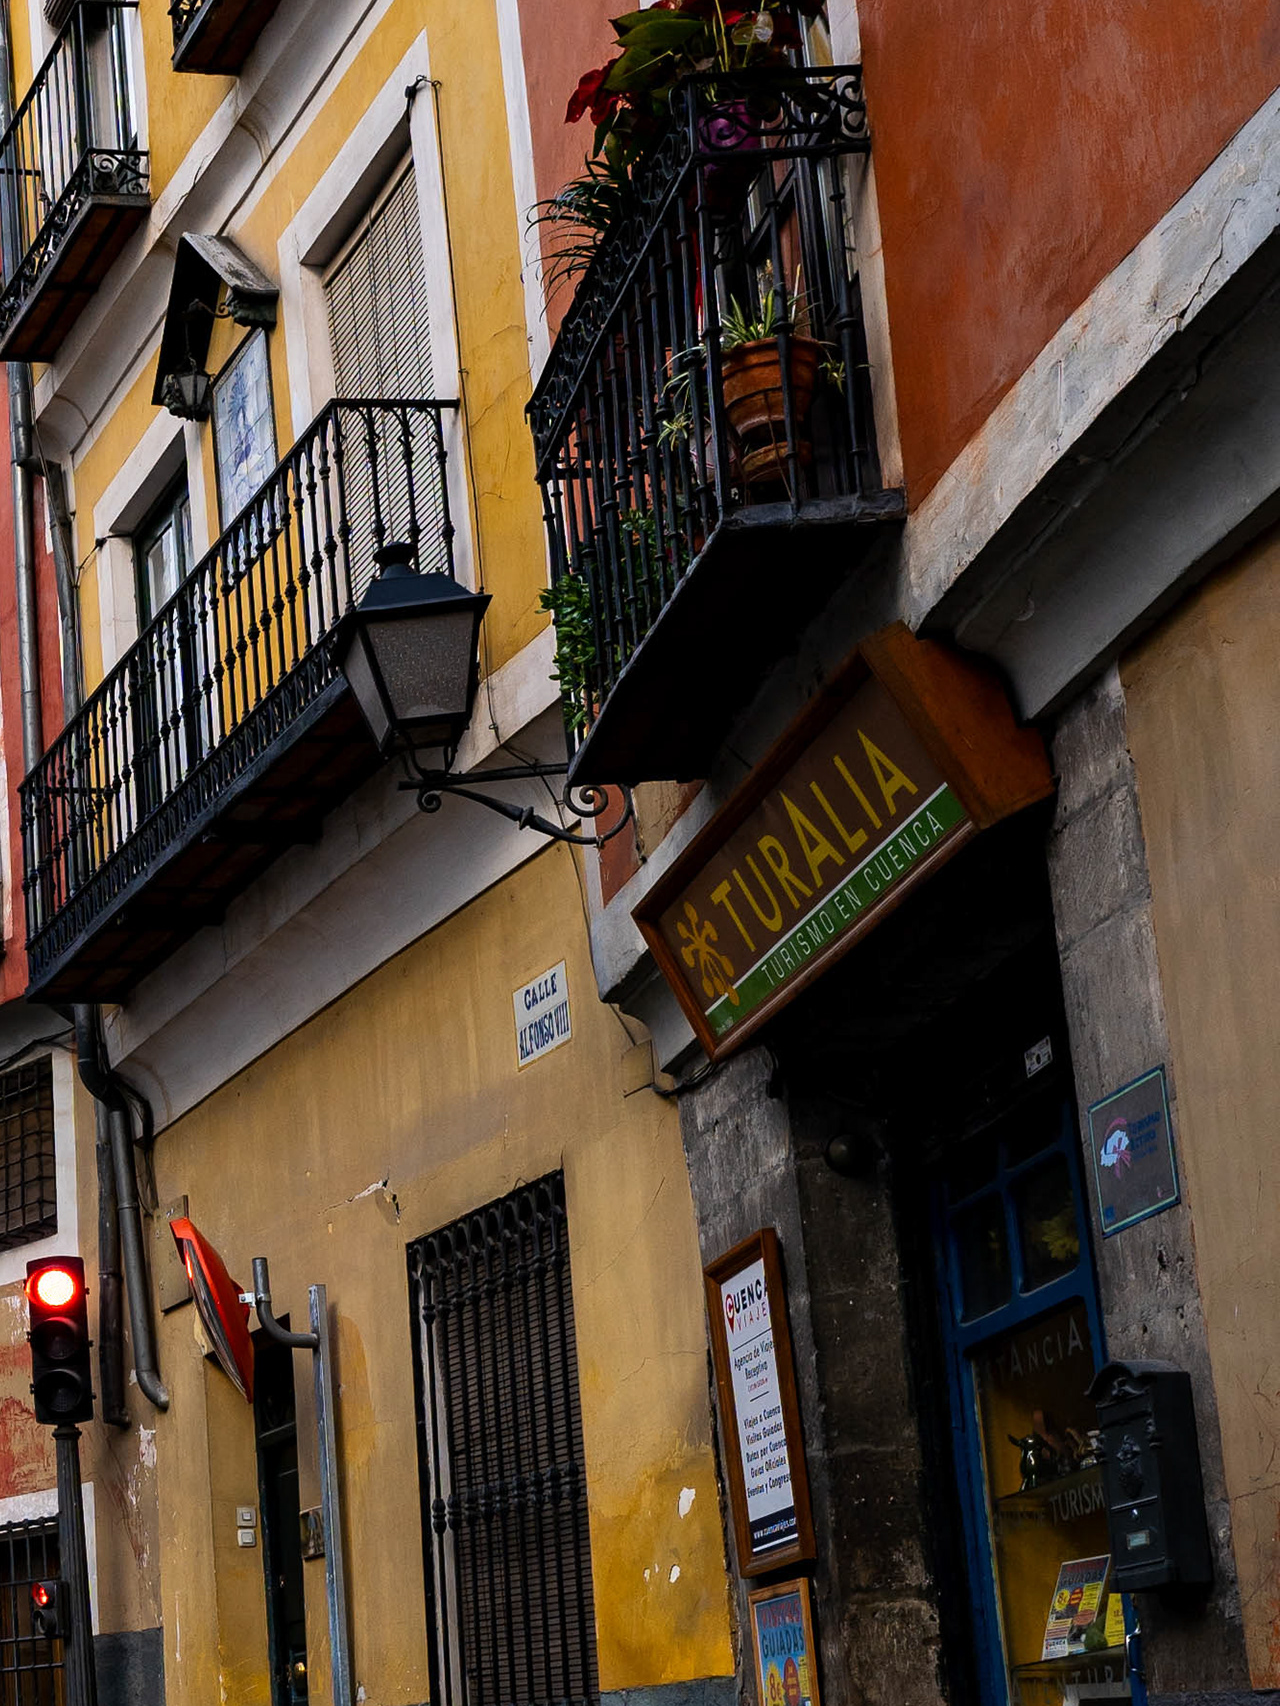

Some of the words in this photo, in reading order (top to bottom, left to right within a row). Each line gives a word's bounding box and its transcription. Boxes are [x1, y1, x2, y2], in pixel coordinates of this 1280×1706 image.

[710, 729, 919, 952] TURALIA
[761, 910, 835, 986] TURISMO
[833, 885, 862, 919] EN
[864, 810, 944, 892] CUENCA
[523, 972, 557, 1011] CALLE
[519, 1011, 555, 1060] ALFONSO
[554, 1000, 570, 1038] VIII
[736, 1301, 768, 1331] VIAJE
[760, 1338, 775, 1355] Viaje
[763, 1405, 781, 1420] Cuenca
[762, 1421, 783, 1439] Guiadas
[768, 1472, 791, 1490] Congres
[1049, 1483, 1106, 1527] TURISM
[762, 1626, 804, 1659] GUIADAS
[769, 1672, 782, 1703] 8€
